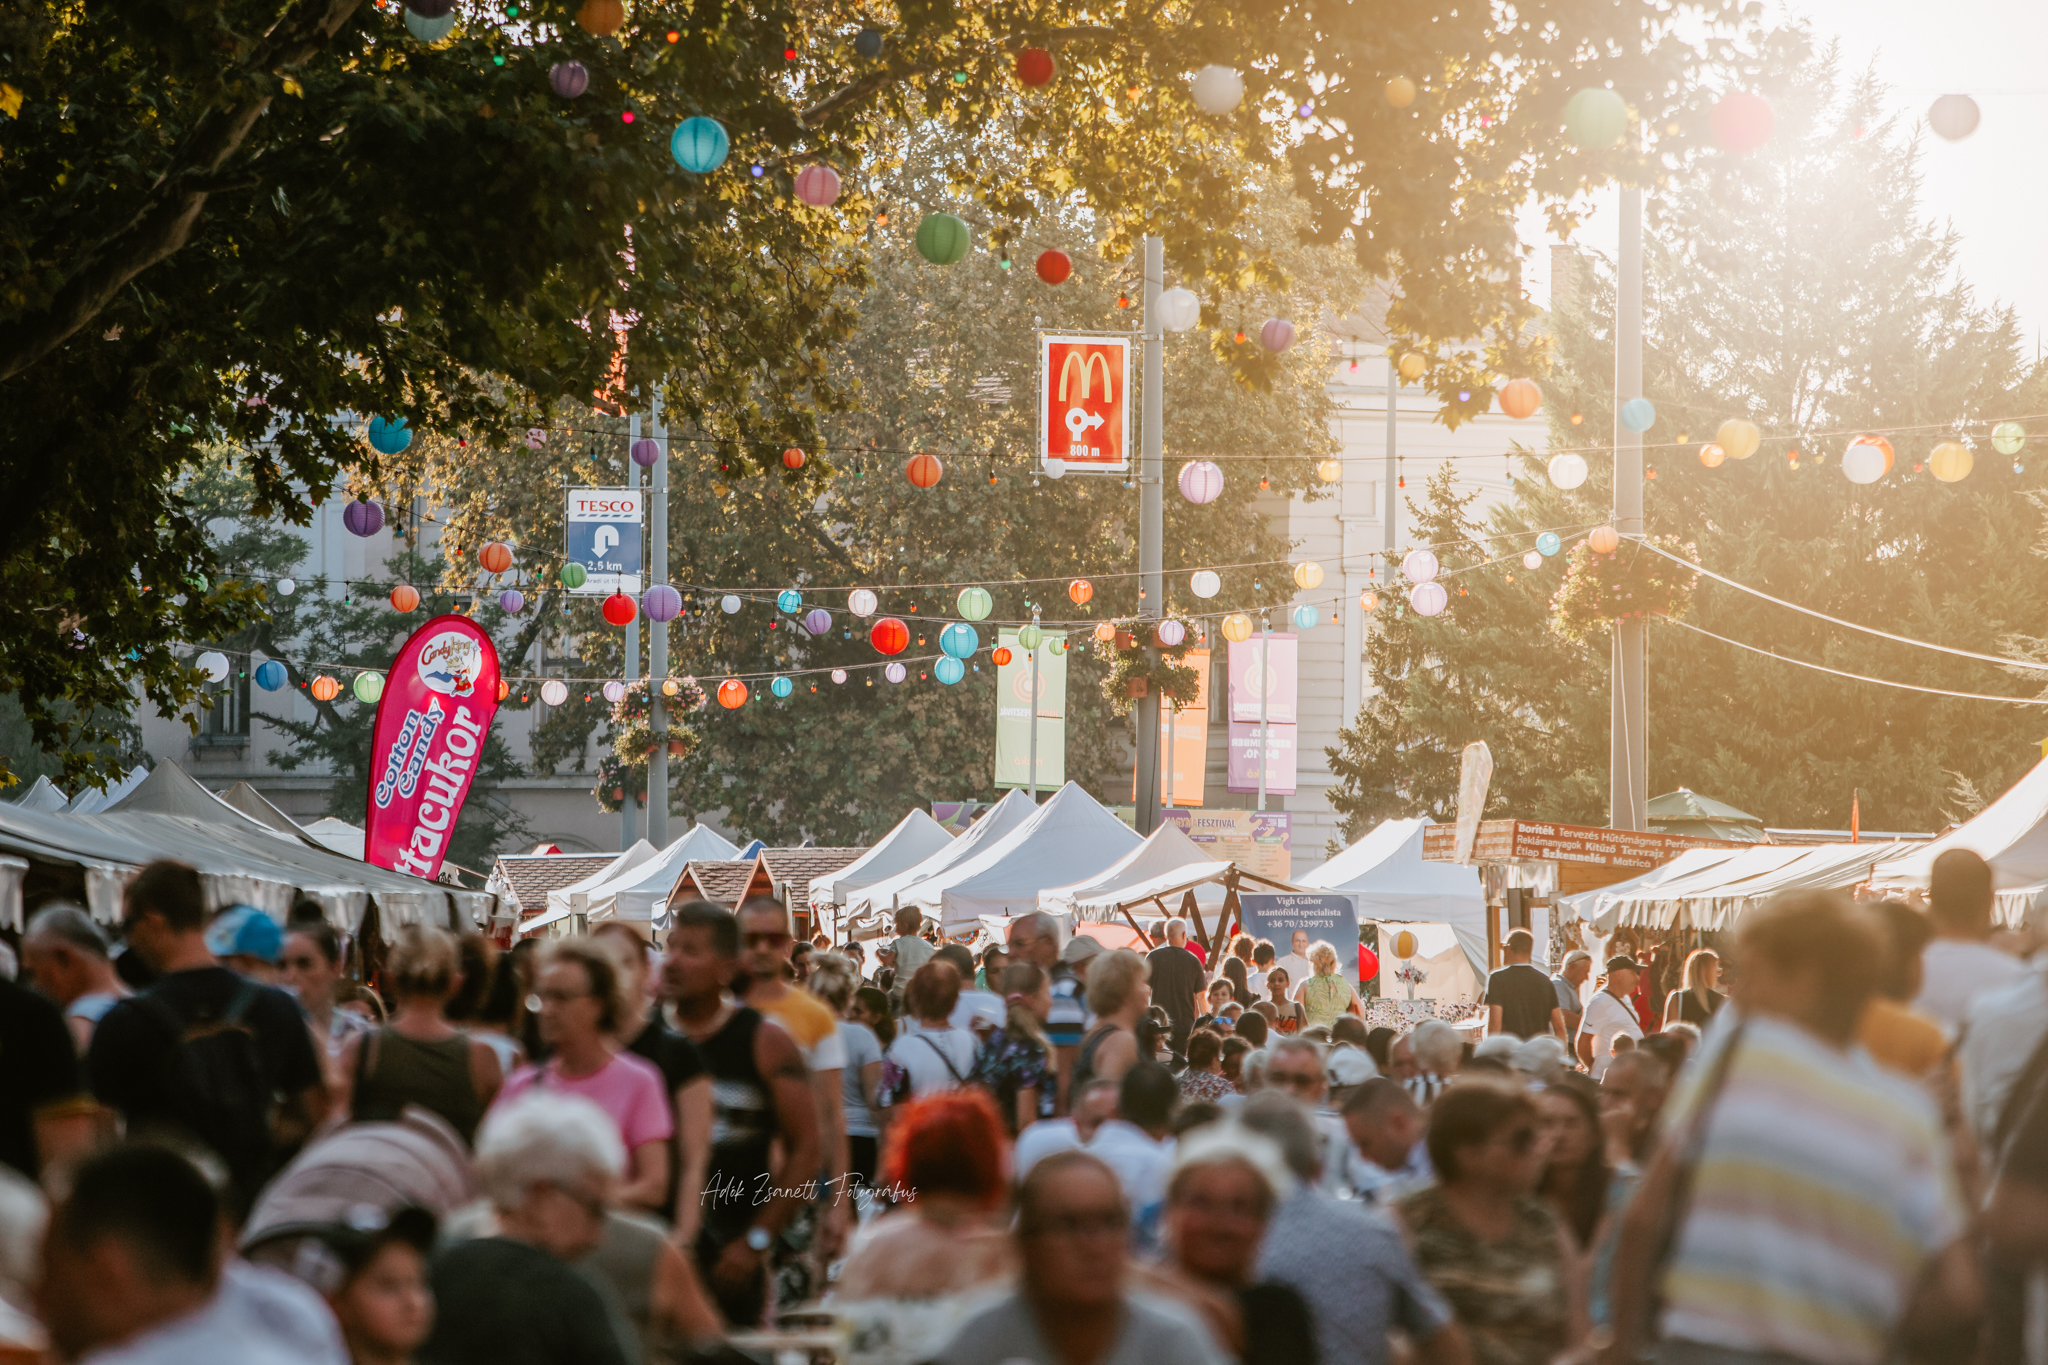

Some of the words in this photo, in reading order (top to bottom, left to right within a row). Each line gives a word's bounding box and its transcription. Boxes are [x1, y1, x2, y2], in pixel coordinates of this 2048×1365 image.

[1070, 444, 1088, 457] 800
[1091, 447, 1100, 457] m
[576, 500, 634, 512] TESCO
[587, 560, 604, 572] 2,5
[606, 560, 622, 571] km
[398, 697, 445, 798] Candy
[375, 709, 421, 809] Cotton
[1518, 823, 1555, 836] Boríték
[1559, 827, 1599, 840] Tervezés
[1601, 832, 1662, 848] Hűtőmágnes
[1516, 834, 1582, 851] Reklámanyagok
[1585, 842, 1616, 854] Kitűző
[1621, 845, 1665, 860] Tervrajz
[1516, 844, 1540, 858] Étlap
[1542, 847, 1606, 864] Szkennelés
[1276, 896, 1295, 907] Vigh
[1297, 895, 1322, 905] Gábor
[1257, 907, 1299, 917] szántóföld
[1300, 908, 1341, 918] specialista
[1267, 919, 1283, 928] +36
[1284, 919, 1334, 929] 70/3299733
